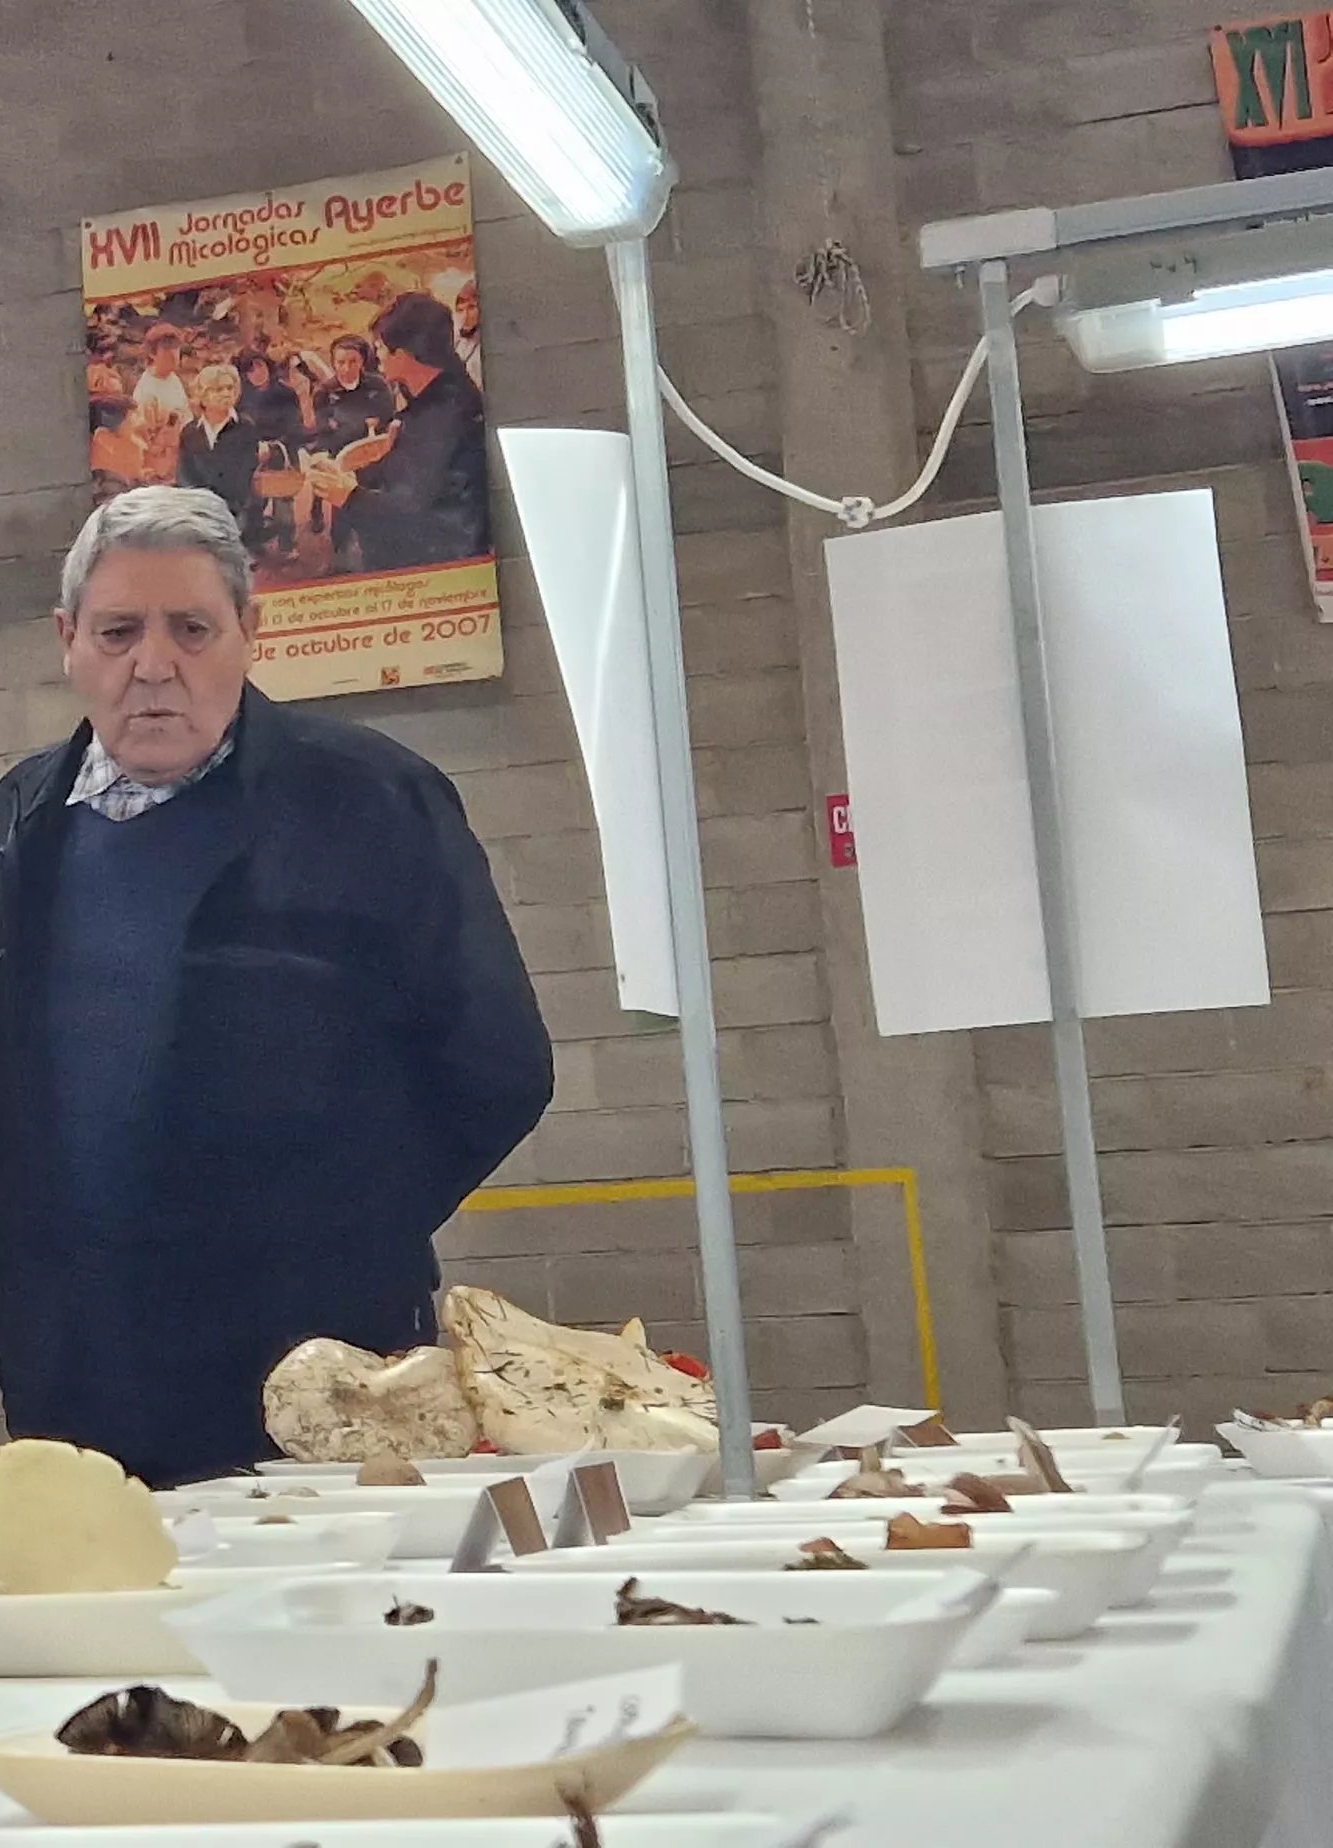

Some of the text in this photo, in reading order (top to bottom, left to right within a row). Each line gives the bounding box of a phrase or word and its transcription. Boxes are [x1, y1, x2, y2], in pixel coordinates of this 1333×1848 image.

[1227, 19, 1313, 130] XVI
[178, 192, 305, 237] Jornadas
[324, 179, 466, 235] Ayerbe
[90, 222, 162, 270] XVII
[168, 226, 322, 268] Micológicas
[285, 633, 374, 658] octubre
[382, 625, 412, 646] de
[420, 613, 491, 642] 2007
